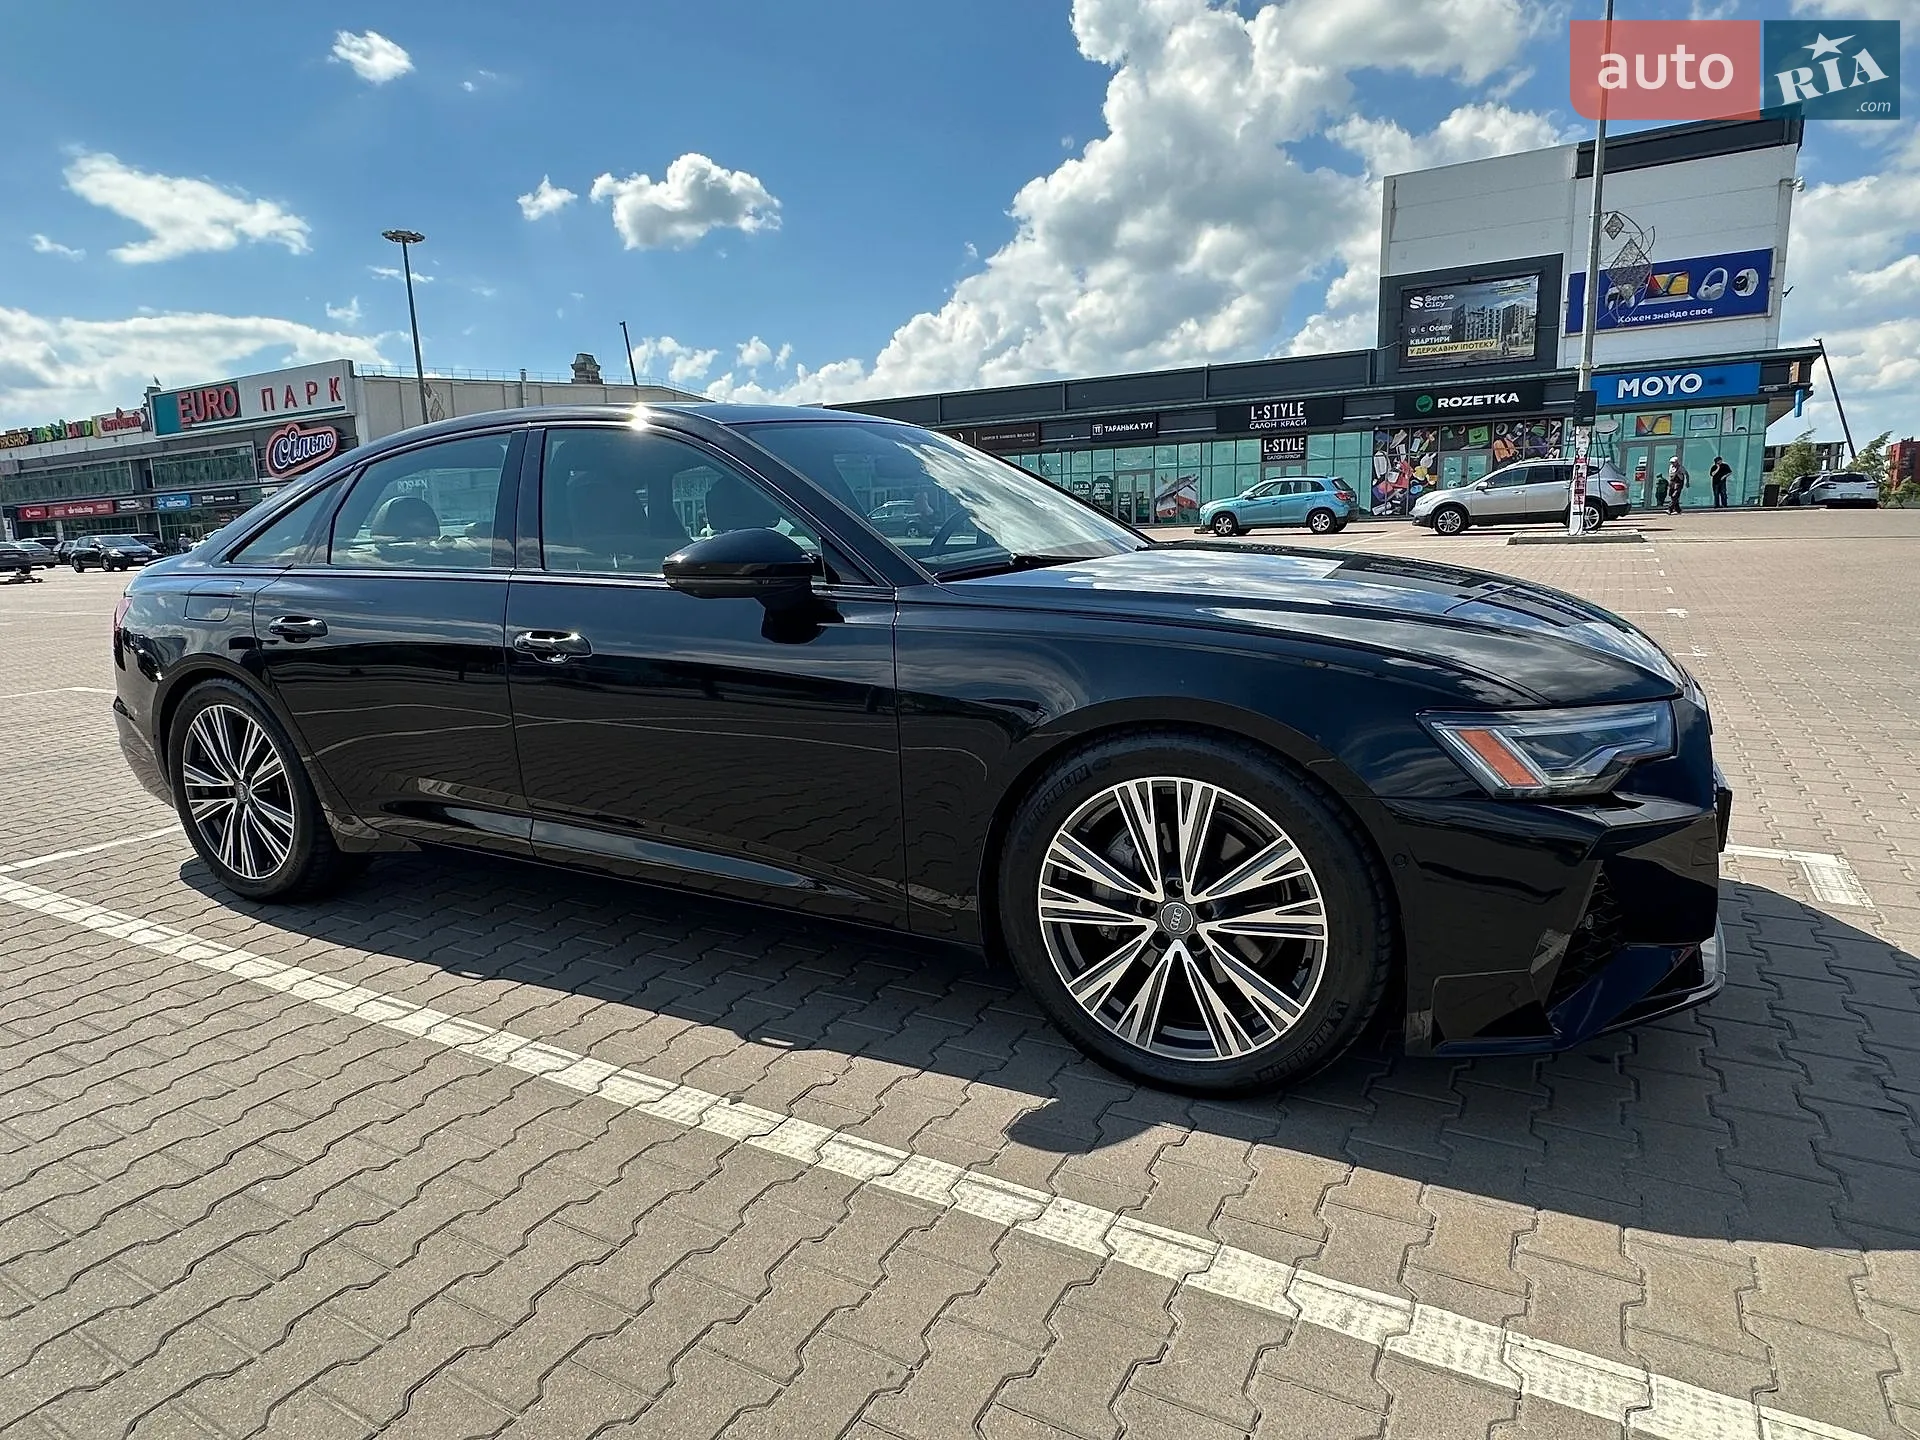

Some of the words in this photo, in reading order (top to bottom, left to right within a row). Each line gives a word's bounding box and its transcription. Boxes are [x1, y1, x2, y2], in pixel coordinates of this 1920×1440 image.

[1416, 344, 1459, 354] ДЕРЖАВНУ
[1617, 373, 1703, 399] MOYO
[177, 385, 239, 424] EURO
[261, 377, 342, 412] ПАРК
[1437, 392, 1520, 409] ROZETKA
[1250, 402, 1305, 420] L-STYLE
[1140, 421, 1154, 430] ТУТ
[1249, 421, 1277, 430] САЛОН
[1280, 419, 1307, 427] КРАСИ
[273, 431, 334, 470] Сільпо
[1263, 437, 1305, 452] L-STYLE
